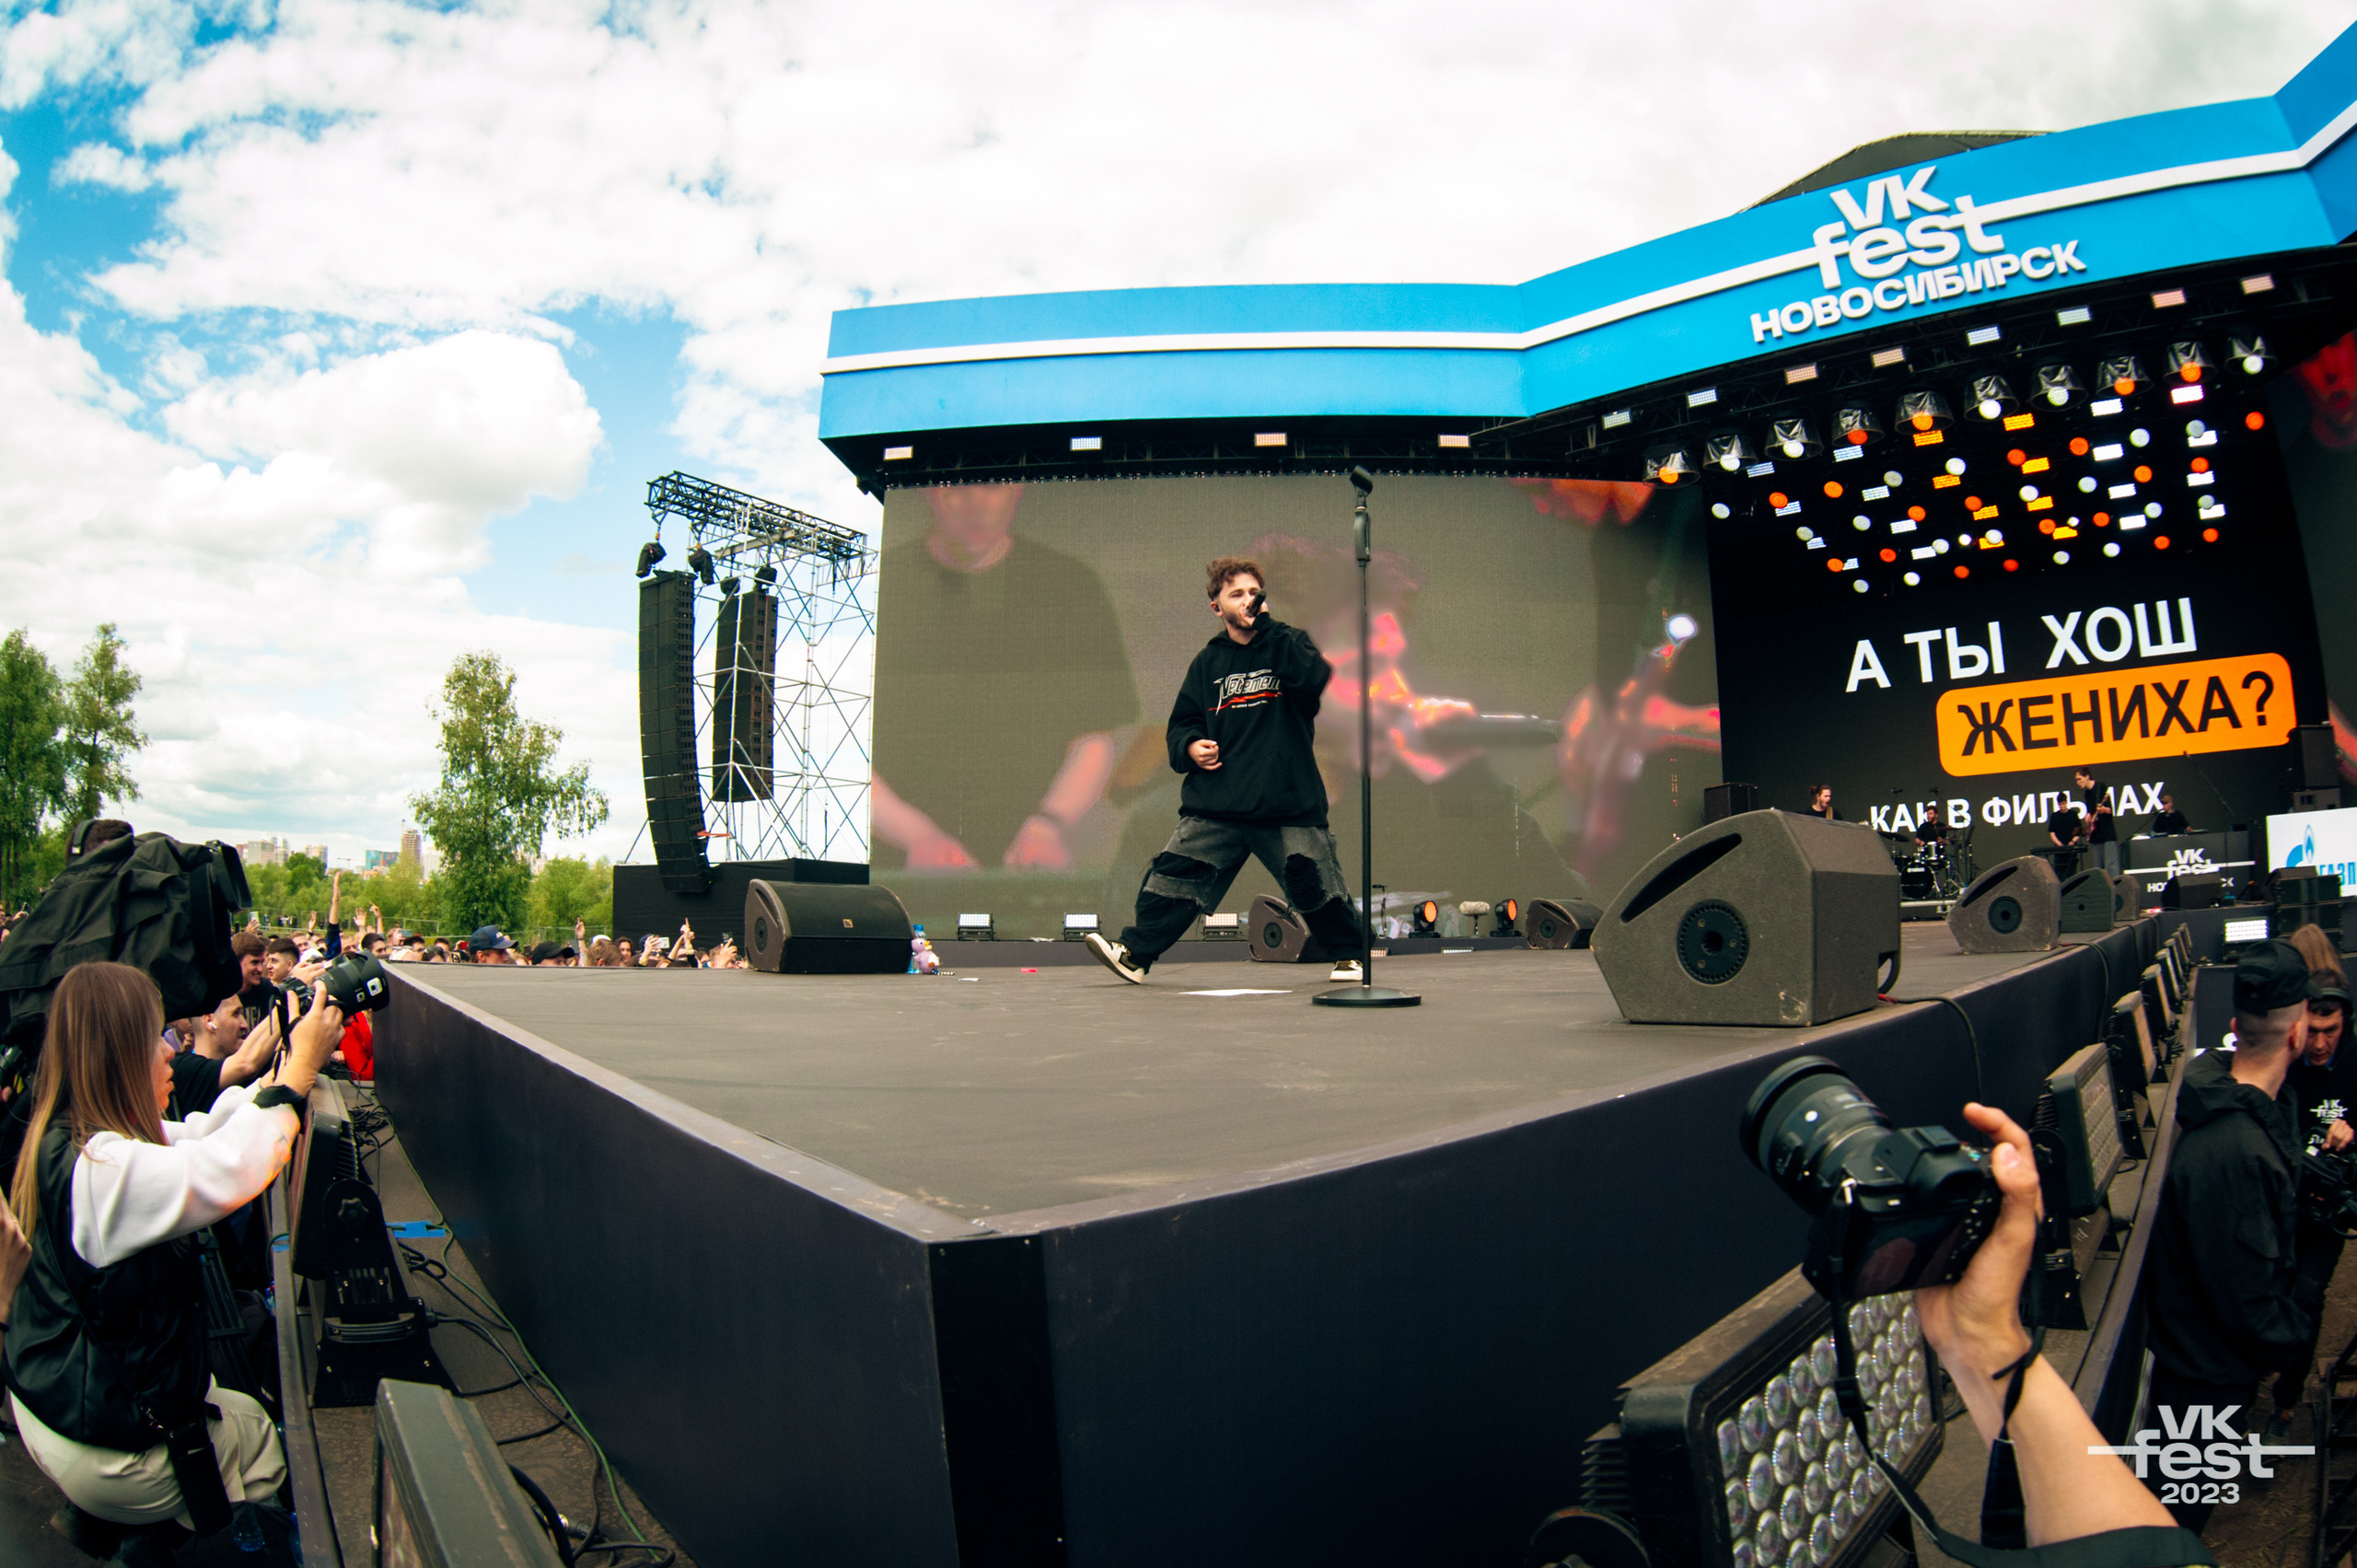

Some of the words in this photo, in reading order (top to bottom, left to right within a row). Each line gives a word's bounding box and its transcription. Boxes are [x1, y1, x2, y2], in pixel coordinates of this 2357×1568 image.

[1829, 166, 1950, 231] VK
[1812, 194, 2005, 290] fest
[1750, 240, 2087, 343] НОВОСИБИРСК
[1845, 639, 1891, 692] А
[1904, 621, 2005, 682] ТЫ
[2041, 598, 2197, 668] ХОШ
[1957, 670, 2274, 756] ЖЕНИХА?
[1946, 798, 1972, 829] В
[2174, 848, 2205, 865] VK
